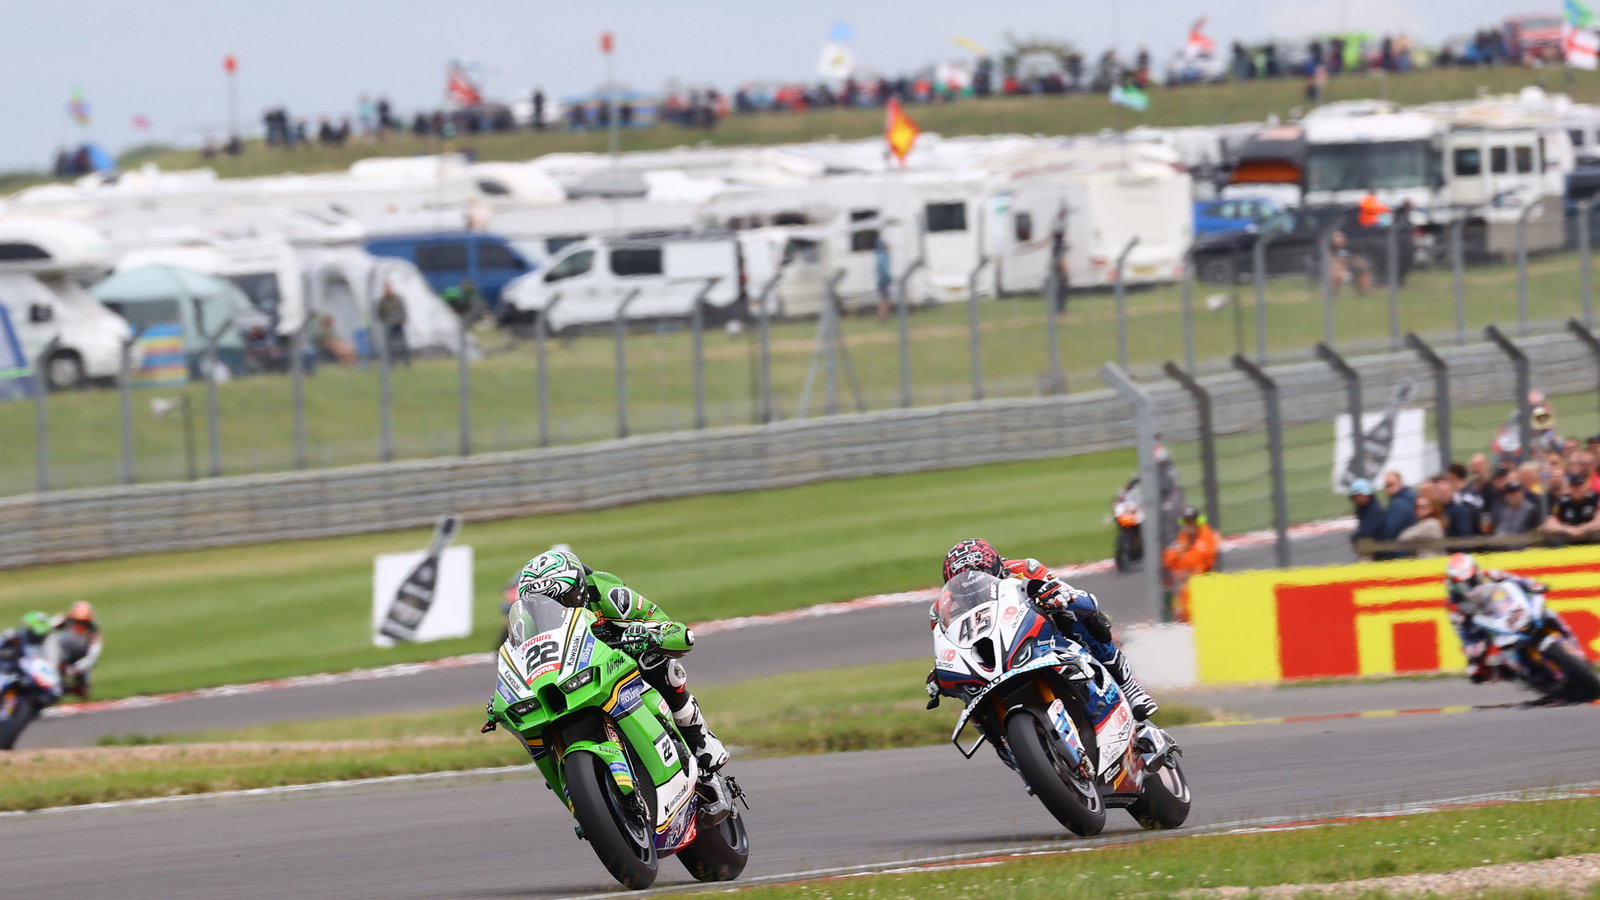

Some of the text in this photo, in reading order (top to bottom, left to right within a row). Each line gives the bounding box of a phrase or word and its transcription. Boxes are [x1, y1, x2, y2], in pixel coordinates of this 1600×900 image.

[959, 607, 992, 641] 45
[521, 634, 552, 652] SHOWA
[567, 635, 581, 666] Kawasaki
[525, 641, 559, 676] 22
[531, 664, 556, 680] MOTUL
[504, 670, 522, 693] Kawasaki
